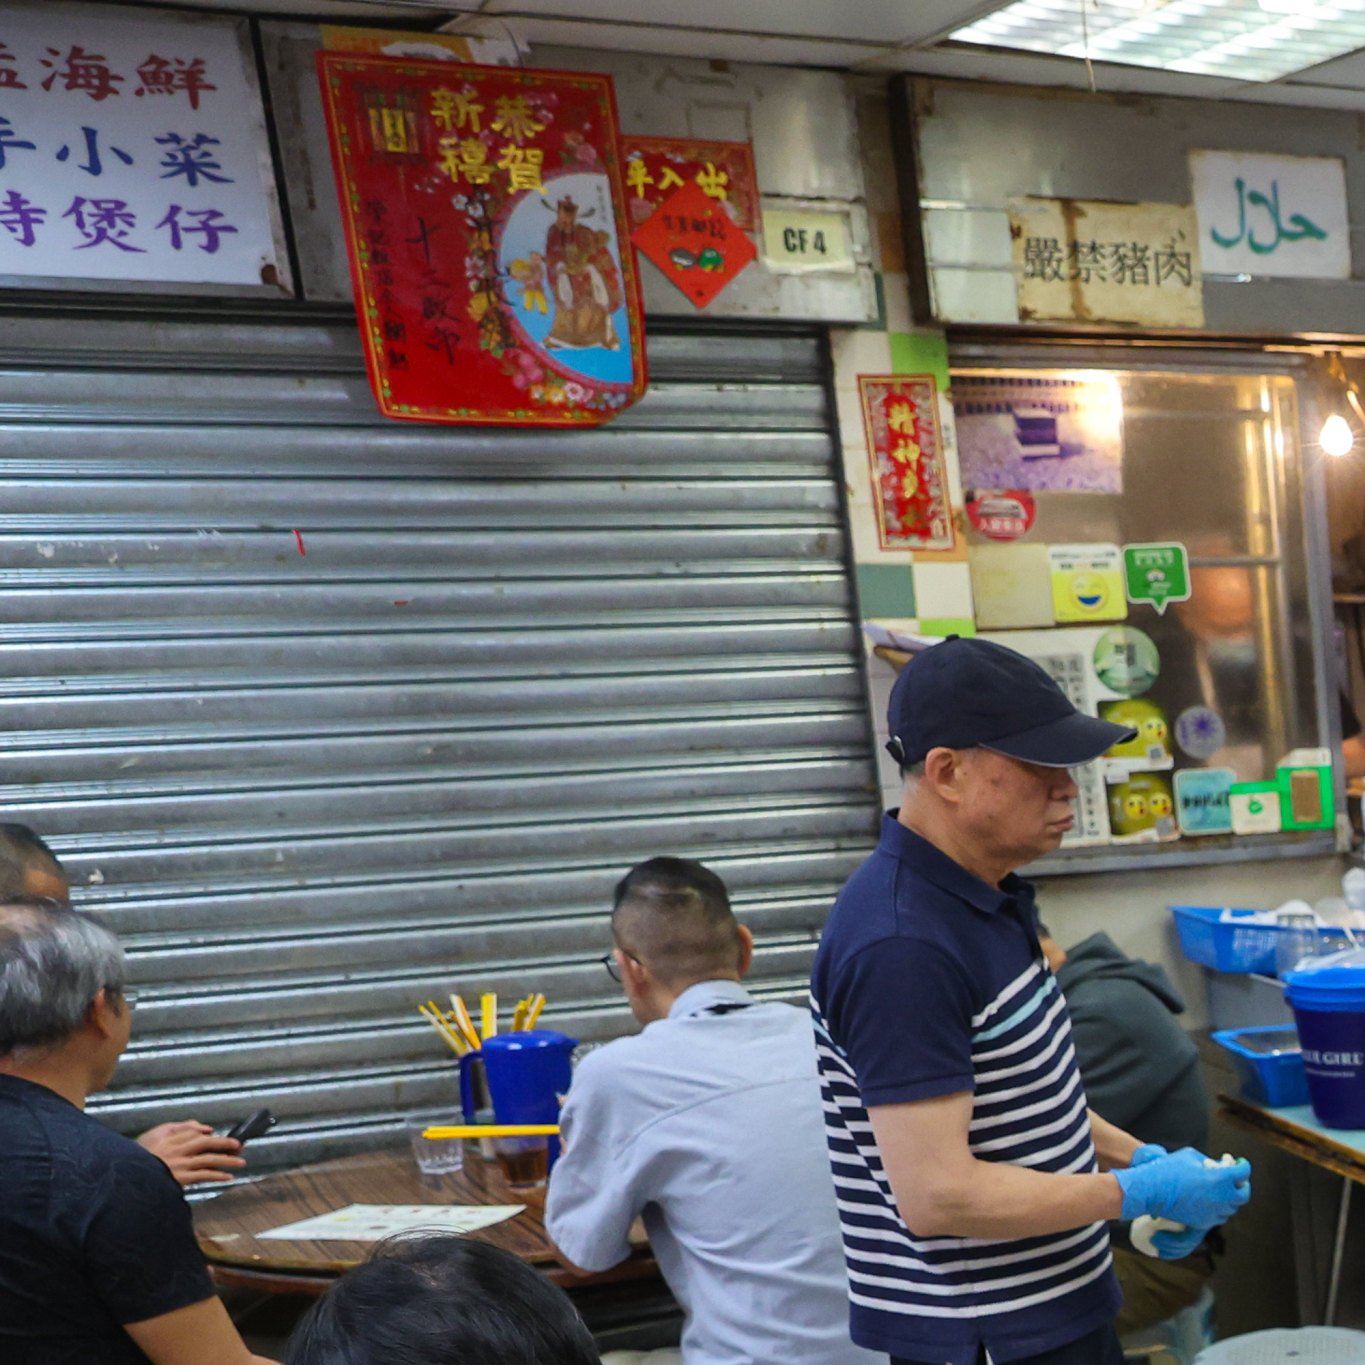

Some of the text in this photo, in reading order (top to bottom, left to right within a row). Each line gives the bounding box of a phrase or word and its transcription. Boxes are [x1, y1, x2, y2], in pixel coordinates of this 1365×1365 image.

[1210, 176, 1327, 255] حلال
[1023, 231, 1193, 288] 嚴禁豬肉
